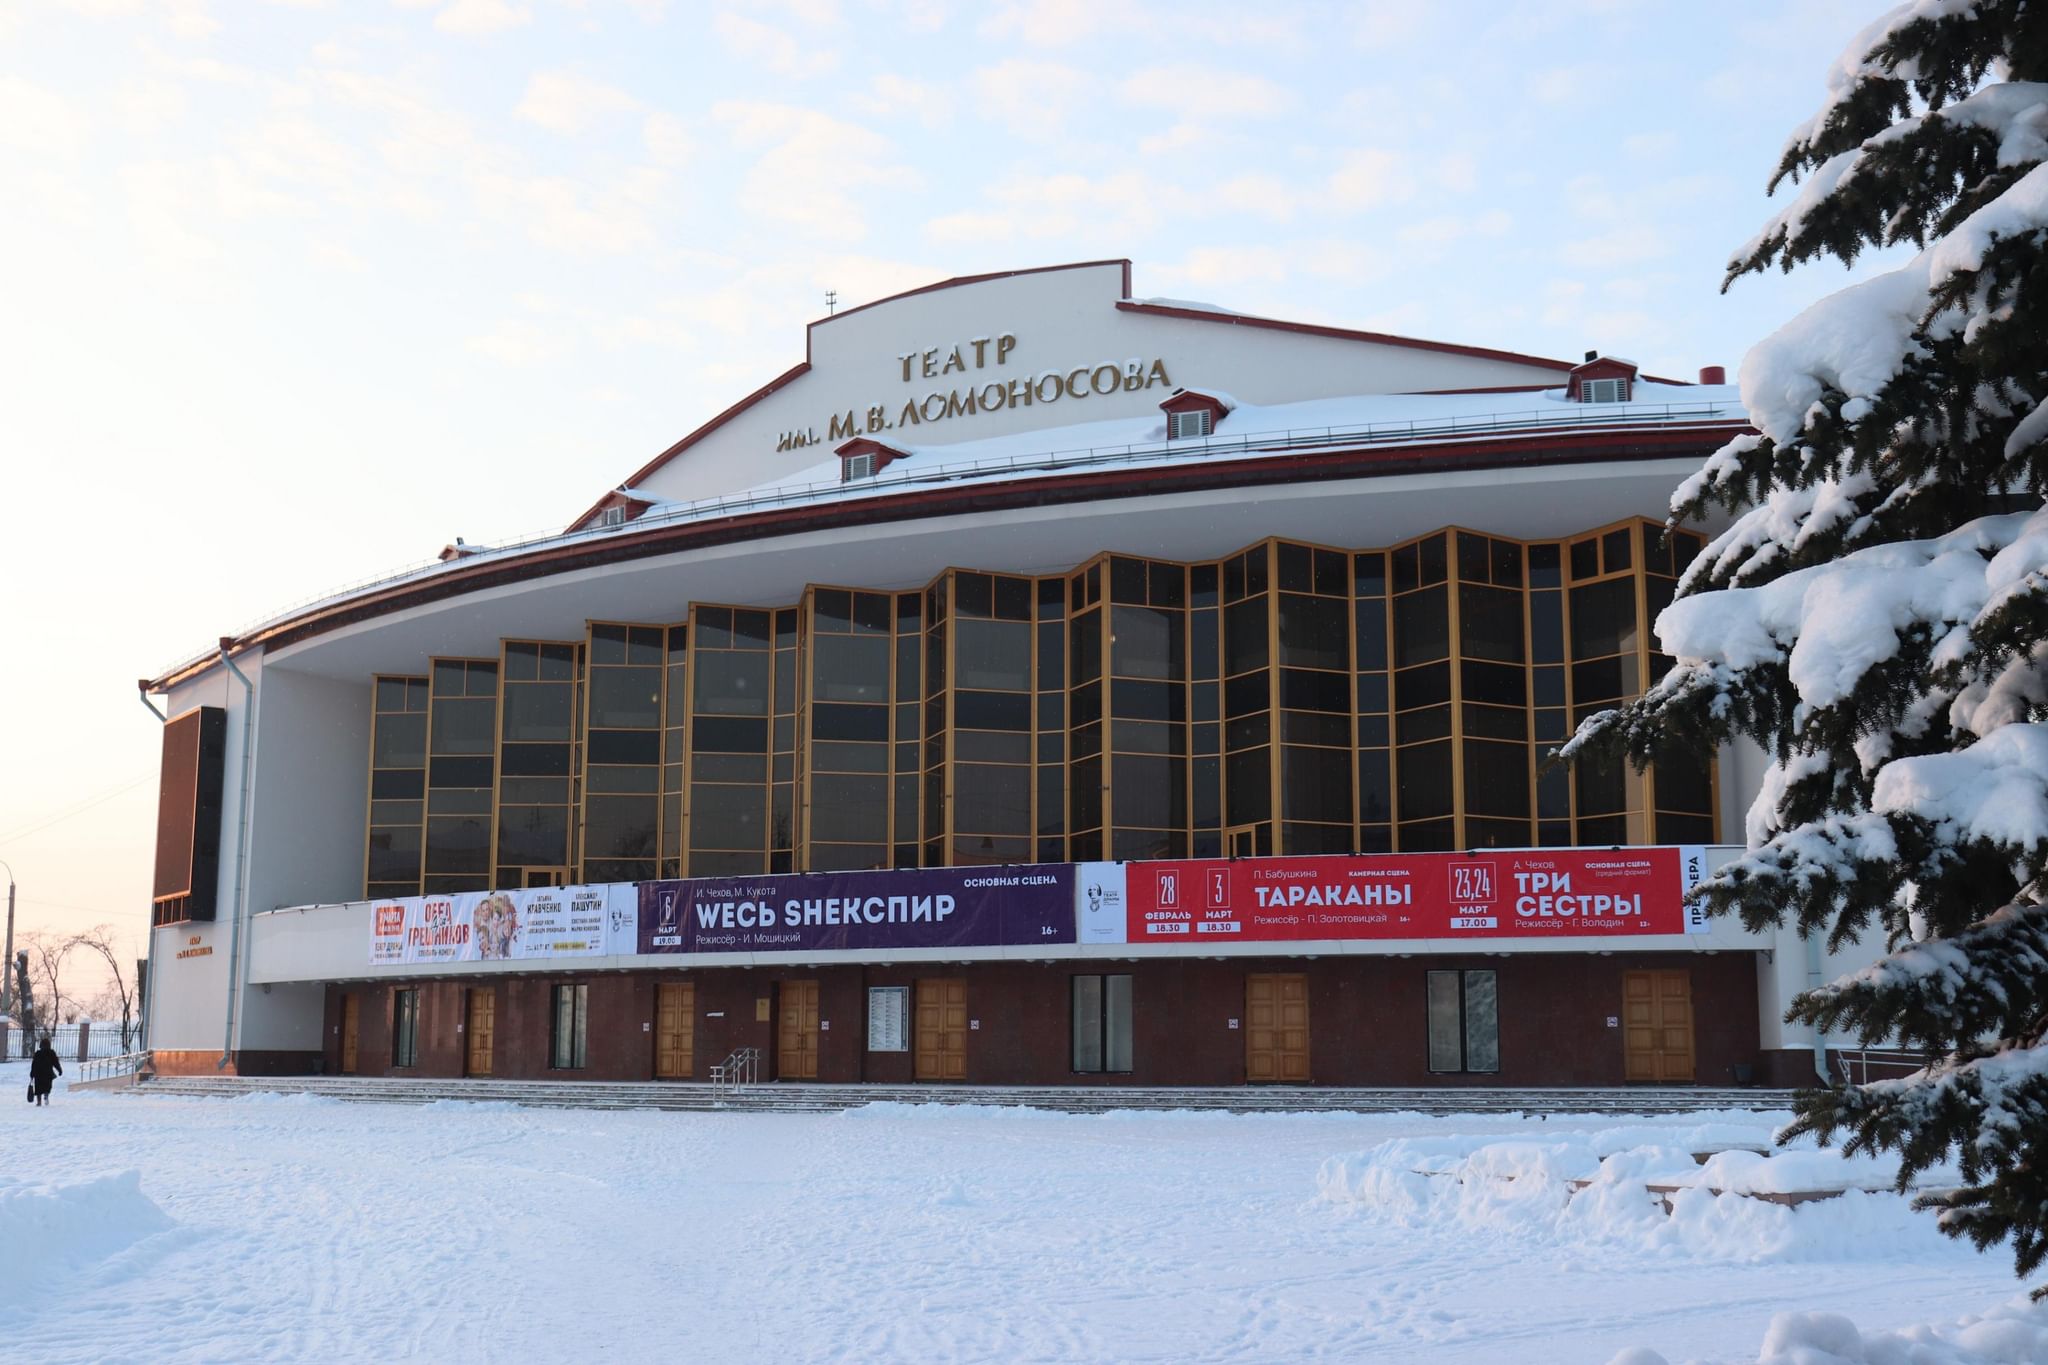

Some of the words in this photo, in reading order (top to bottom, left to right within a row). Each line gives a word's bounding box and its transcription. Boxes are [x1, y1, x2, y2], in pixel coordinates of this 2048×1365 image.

[898, 331, 1017, 382] ТЕАТР
[898, 358, 1171, 427] ЛОМОНОСОВА
[1513, 861, 1522, 870] А.
[1525, 860, 1555, 870] Чехов
[964, 877, 1019, 888] ОСНОВНАЯ
[1021, 875, 1058, 886] СЦЕНА
[1254, 871, 1263, 879] П.
[1265, 870, 1317, 881] Бабушкина
[1215, 874, 1222, 903] 3
[1514, 872, 1571, 894] ТРИ
[706, 888, 733, 899] Чехов,
[734, 888, 745, 897] М.
[746, 886, 776, 899] Кукота
[1161, 876, 1175, 904] 28
[1254, 884, 1412, 907] ТАРАКАНЫ
[1688, 856, 1702, 925] ПРЕЬЕРА
[527, 902, 562, 914] КРАВЧЕНКО
[571, 900, 602, 912] ПАШУТИН
[1459, 905, 1488, 914] МАРТ
[1515, 894, 1641, 917] СЕСТРЫ
[1145, 911, 1192, 920] ФЕВРАЛЬ
[1205, 910, 1232, 919] МАРТ
[1254, 914, 1299, 926] Режиссёр
[1307, 914, 1317, 923] П.
[1319, 913, 1387, 925] Золотовицкая
[1155, 924, 1180, 932] 18.30
[1206, 923, 1231, 931] 18.30
[1460, 918, 1487, 927] 17.00
[1515, 919, 1563, 929] Режиссёр
[1572, 919, 1580, 927] Г.
[1582, 918, 1624, 929] Володин
[1041, 926, 1058, 936] 16+
[696, 935, 736, 946] Режиссёр
[744, 935, 752, 943] И.
[754, 932, 801, 945] Мошицкий
